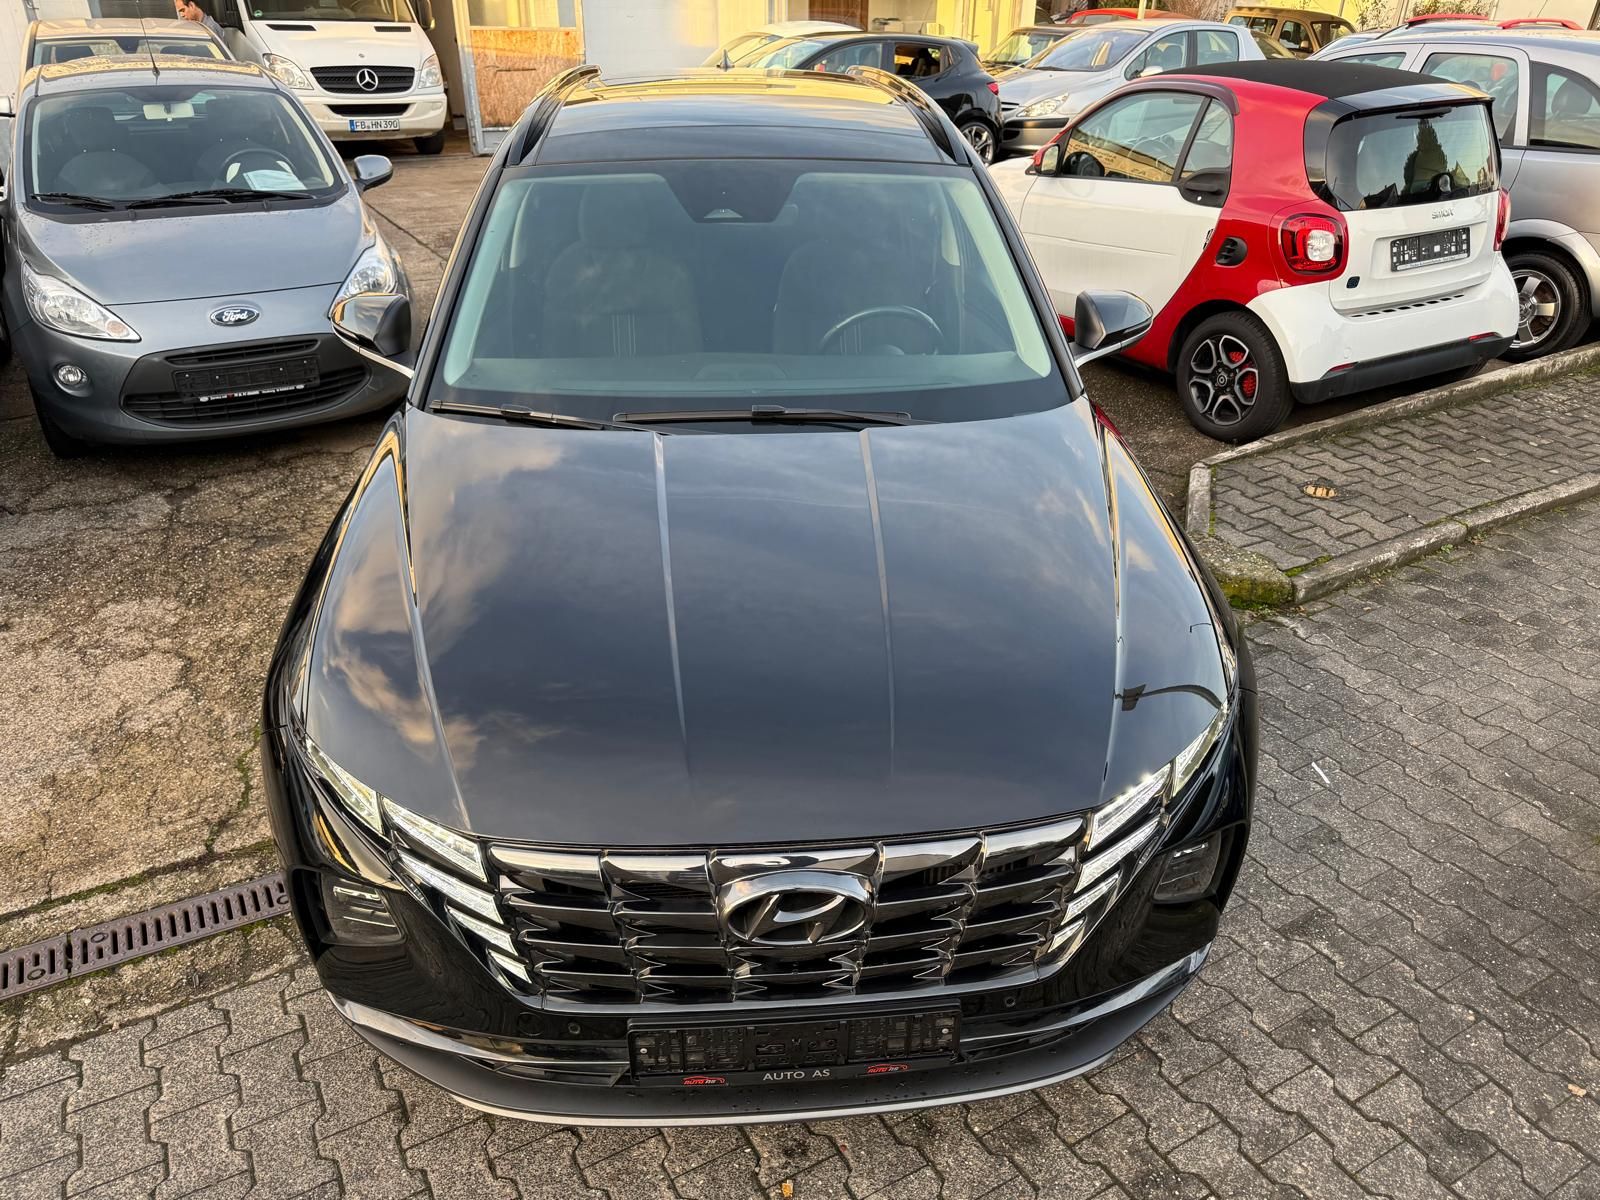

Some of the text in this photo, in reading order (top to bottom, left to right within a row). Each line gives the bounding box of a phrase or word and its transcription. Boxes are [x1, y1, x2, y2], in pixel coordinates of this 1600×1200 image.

[355, 120, 398, 129] FB HN 390
[222, 309, 249, 322] Ford
[763, 1069, 831, 1081] AUTO AS
